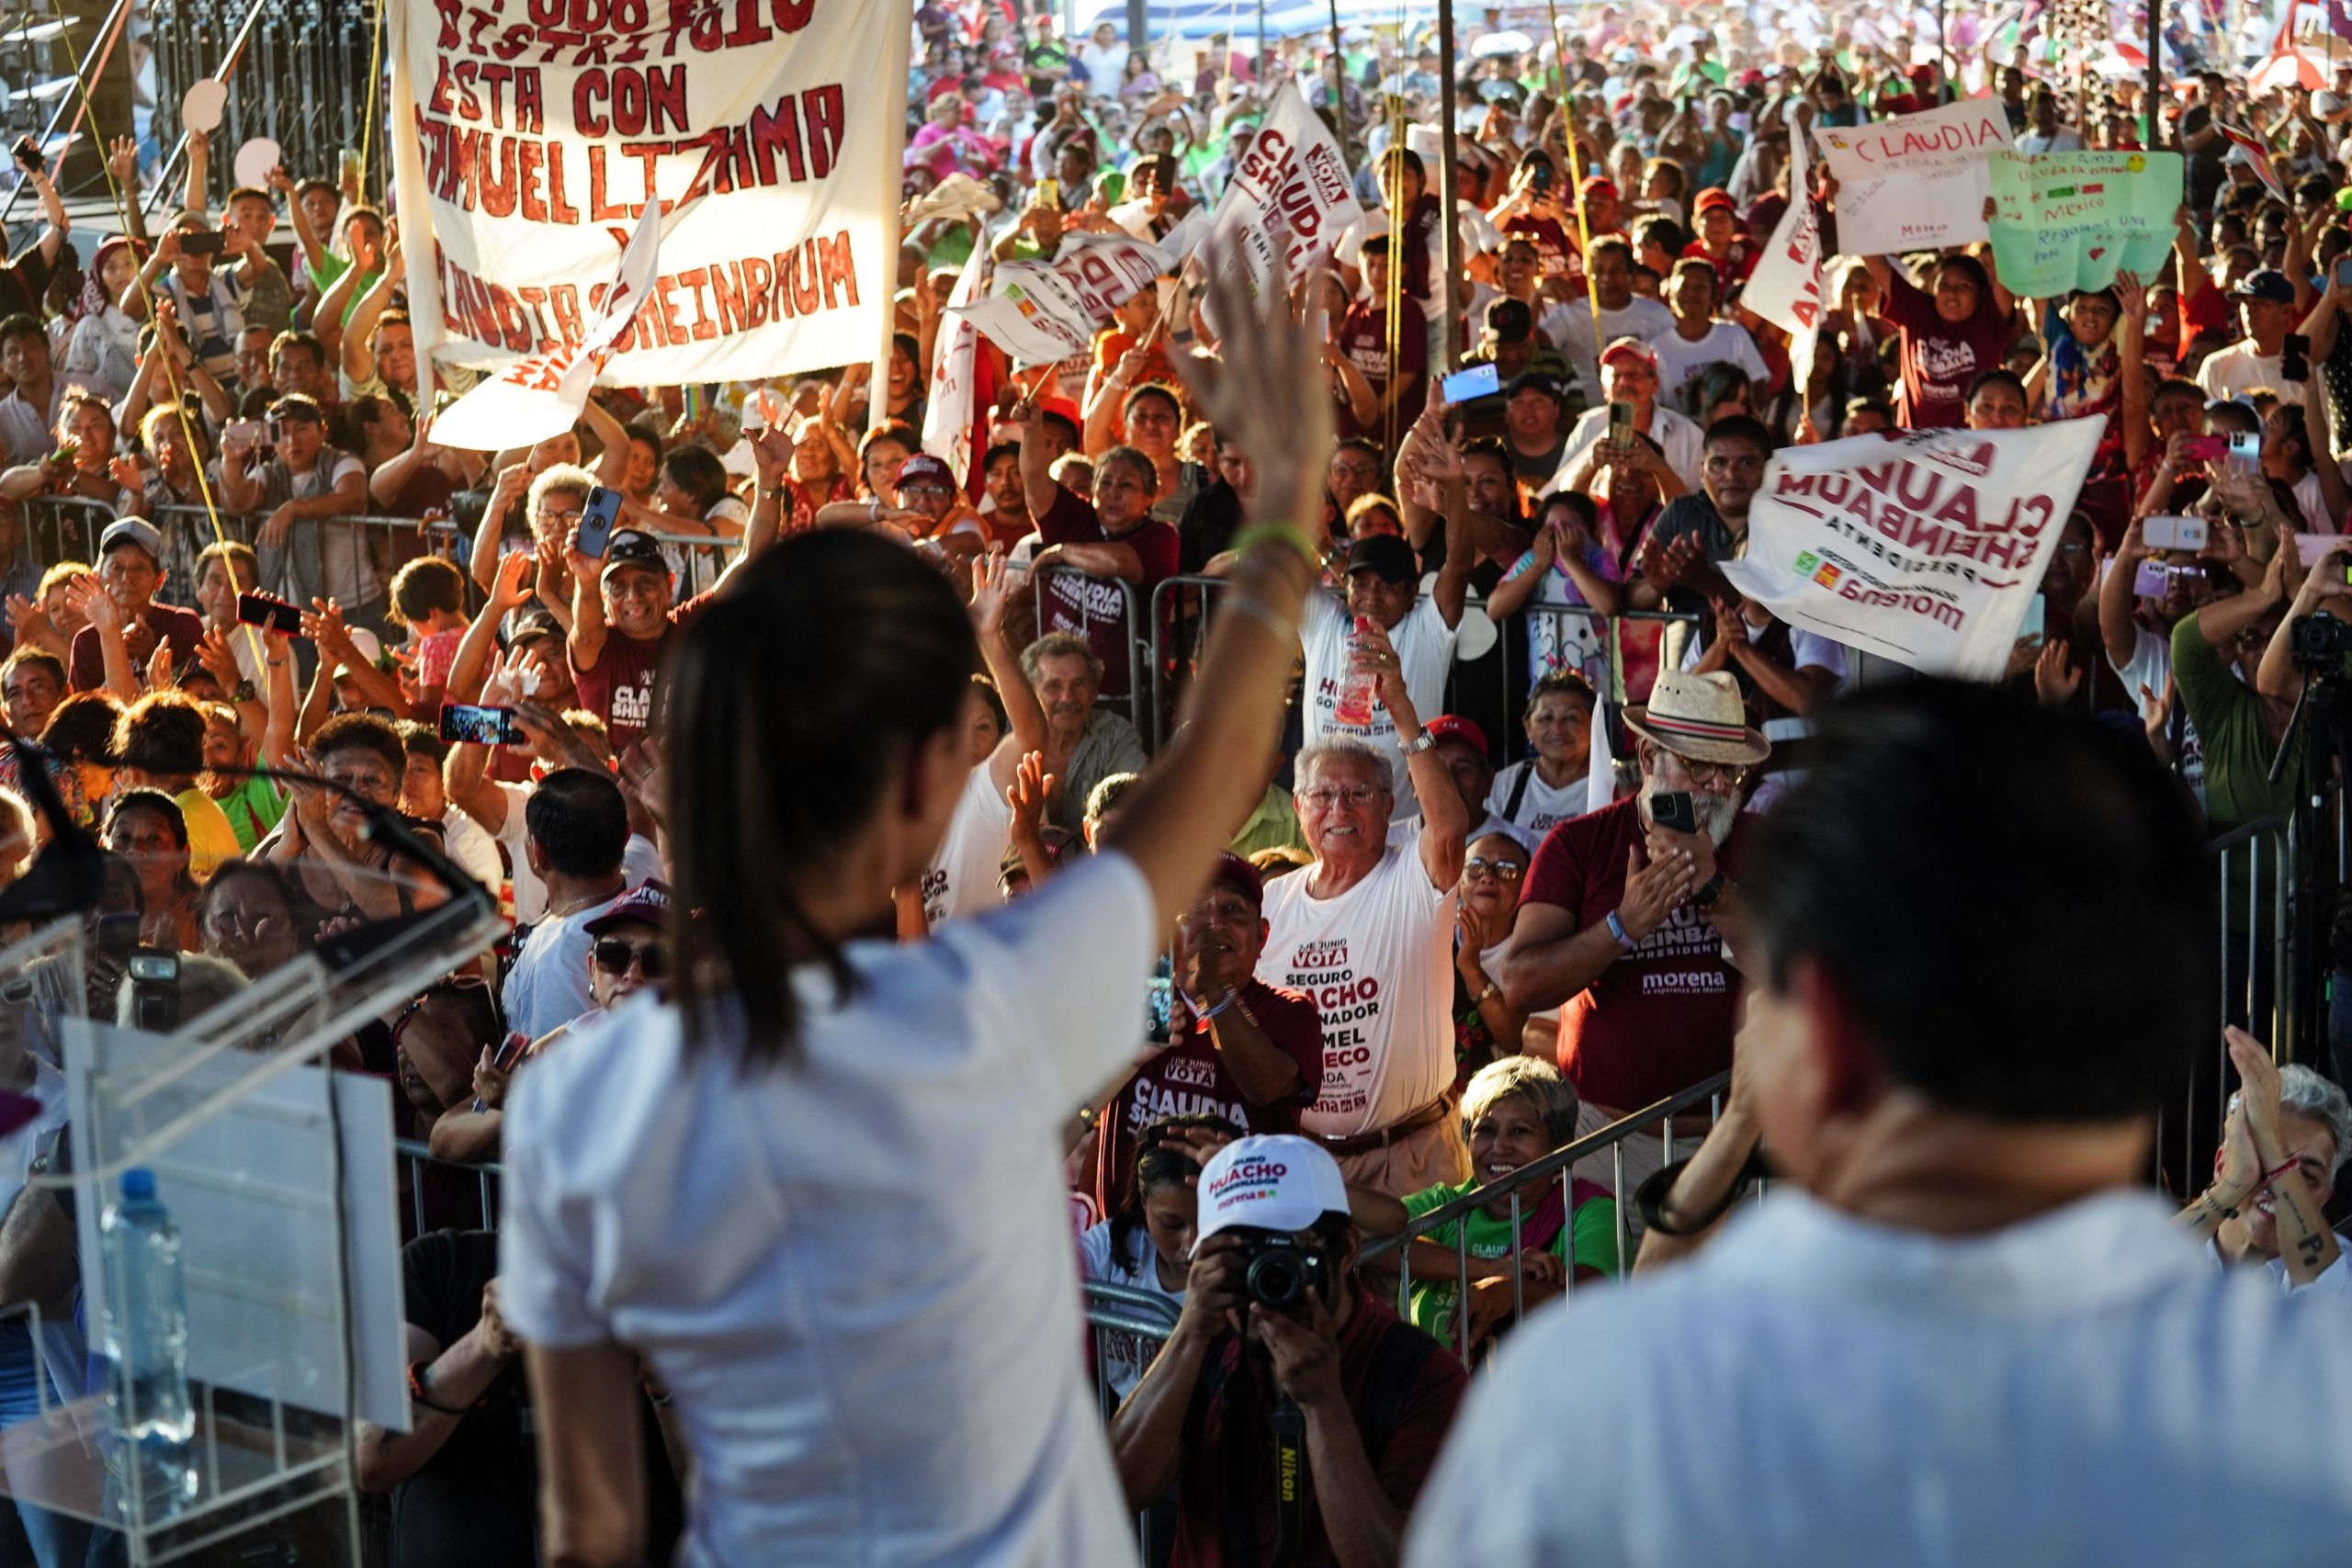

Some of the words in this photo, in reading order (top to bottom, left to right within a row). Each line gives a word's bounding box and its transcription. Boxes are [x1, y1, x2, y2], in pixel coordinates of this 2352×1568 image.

[429, 55, 543, 135] ESTA
[573, 63, 689, 138] CON
[1856, 118, 2004, 163] CLAUDIA
[1313, 150, 1345, 201] VOTA
[615, 685, 651, 705] CLA
[1318, 937, 1348, 950] JUNIO
[1295, 949, 1346, 968] VOTA
[1285, 969, 1353, 987] SEGURO
[1643, 971, 1725, 989] morena
[1166, 1065, 1216, 1089] VOTA
[1209, 1162, 1288, 1195] HUACHO
[1282, 1448, 1296, 1502] Nikon
